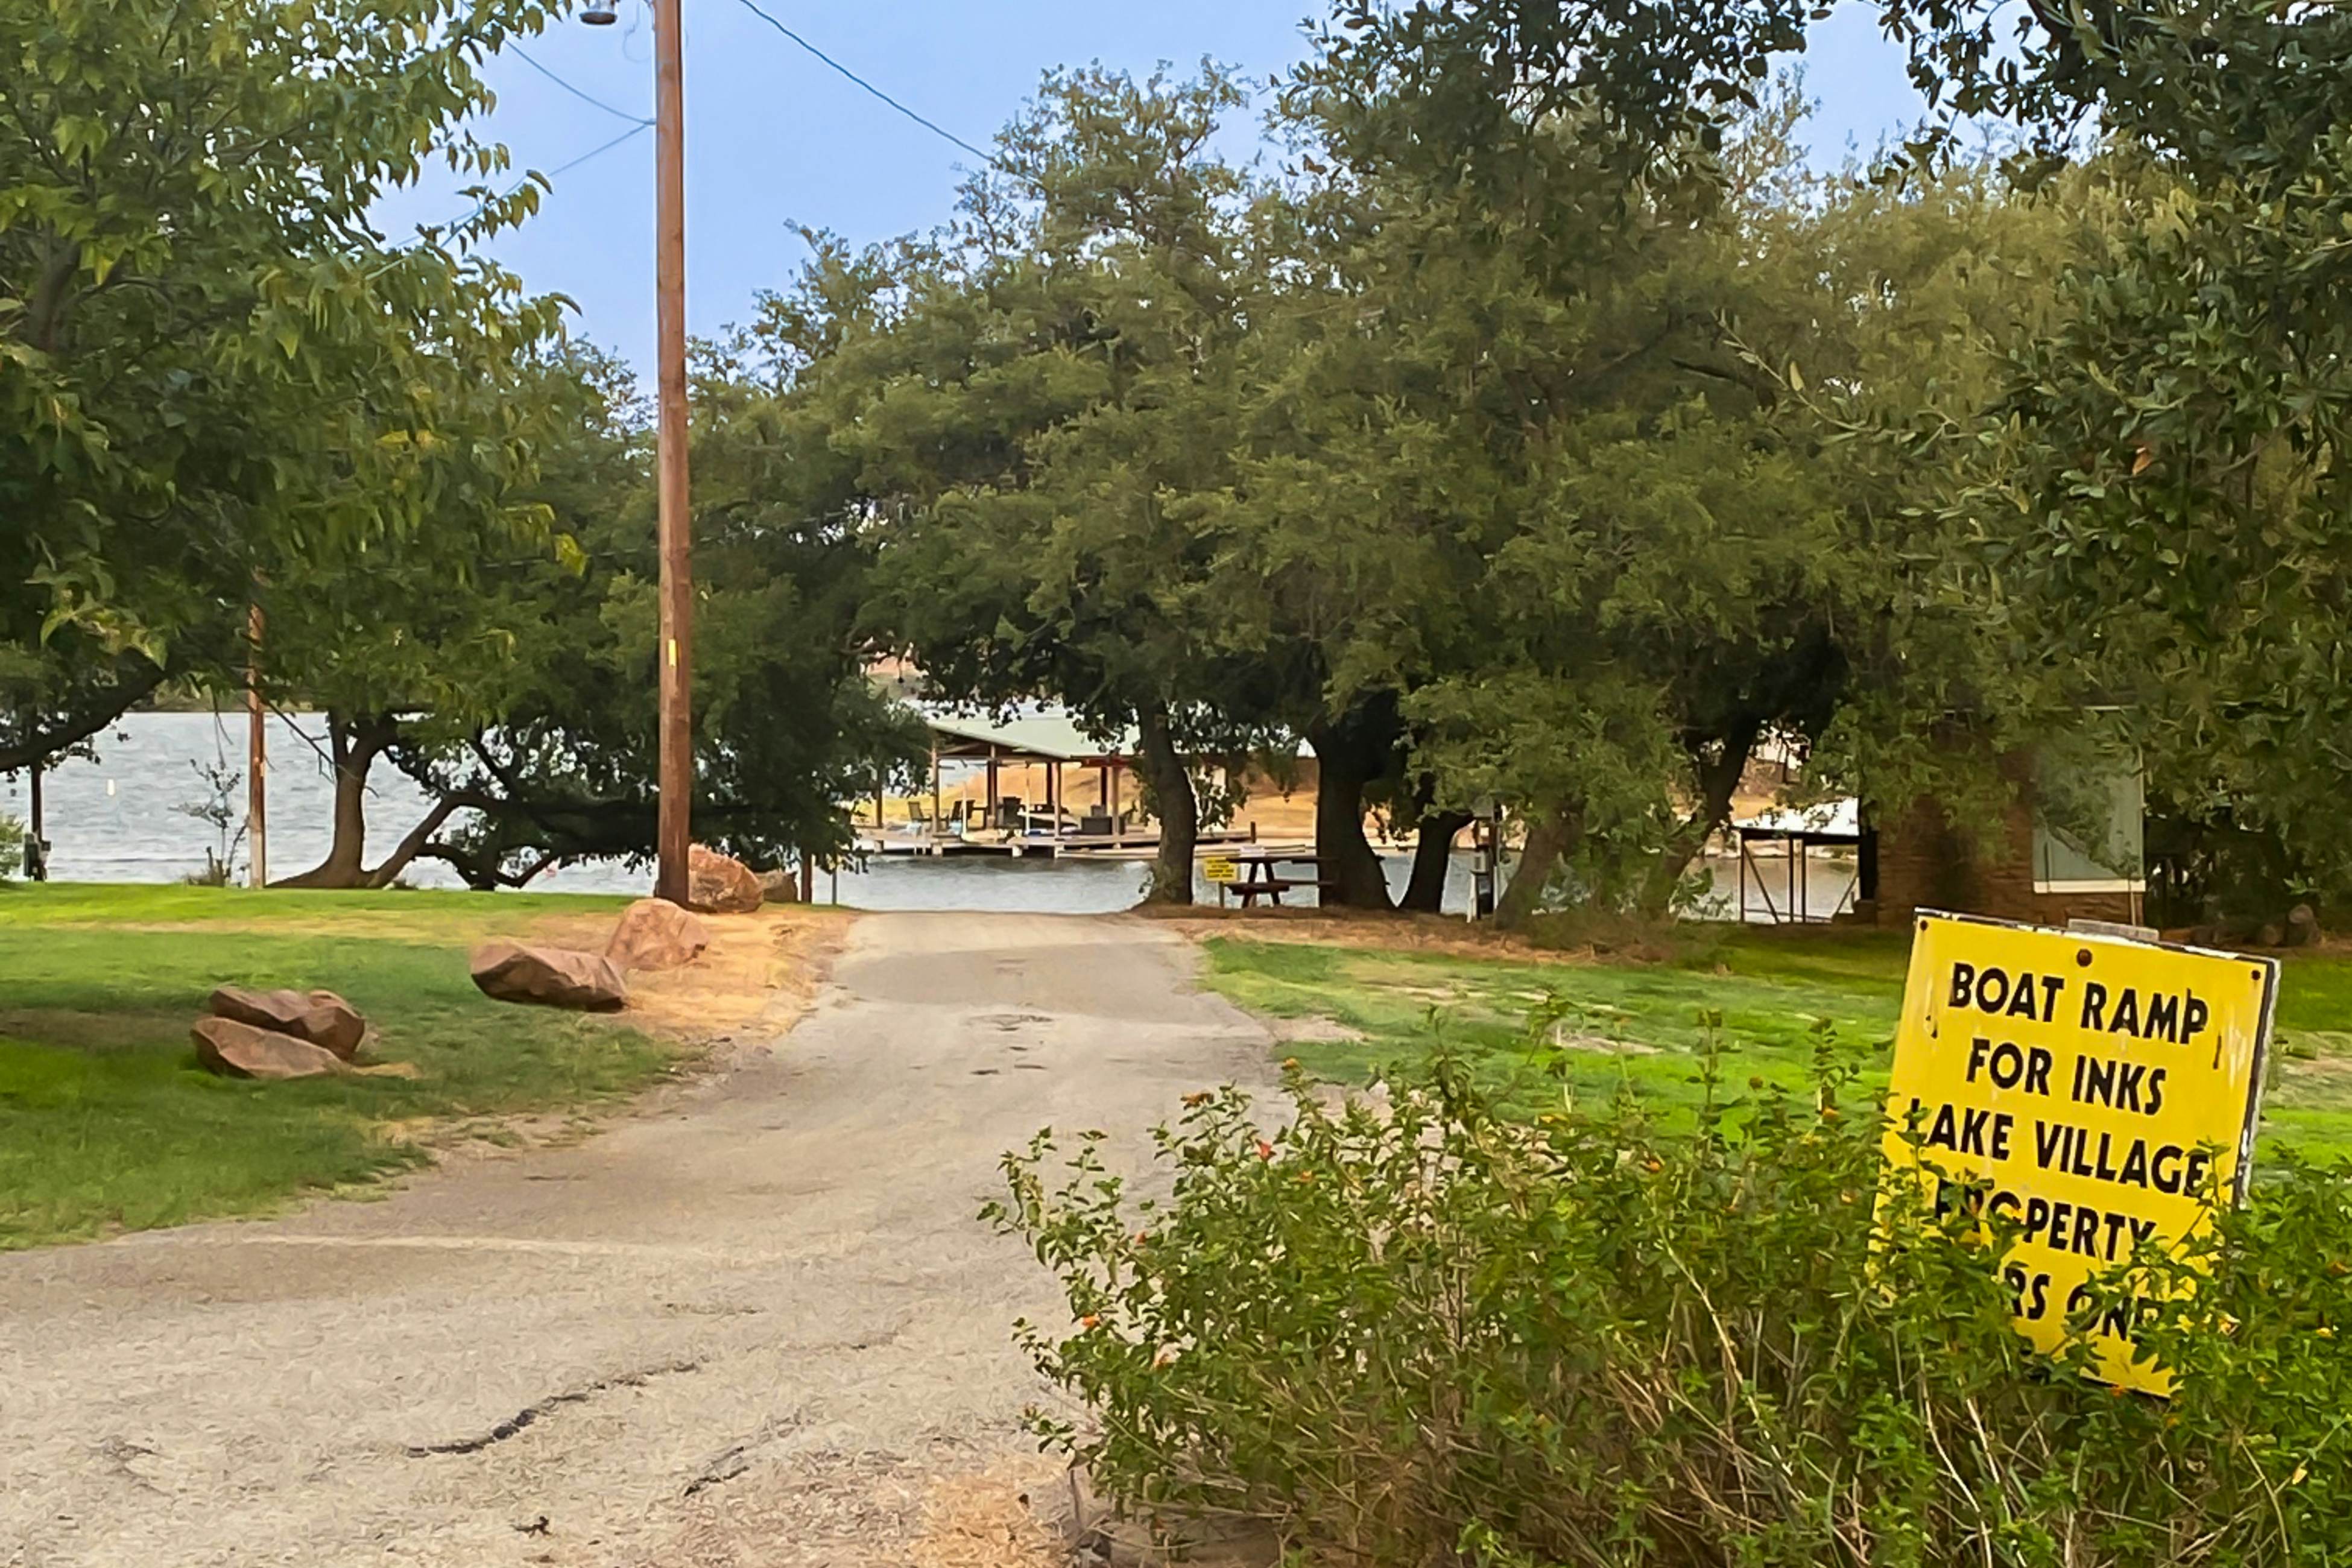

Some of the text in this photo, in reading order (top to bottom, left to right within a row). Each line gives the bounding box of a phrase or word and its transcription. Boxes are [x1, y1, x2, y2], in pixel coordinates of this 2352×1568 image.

[1949, 963, 2208, 1044] BOAT RAMP
[1966, 1038, 2166, 1115] FOR INKS
[2036, 1121, 2210, 1198] VILLAGE
